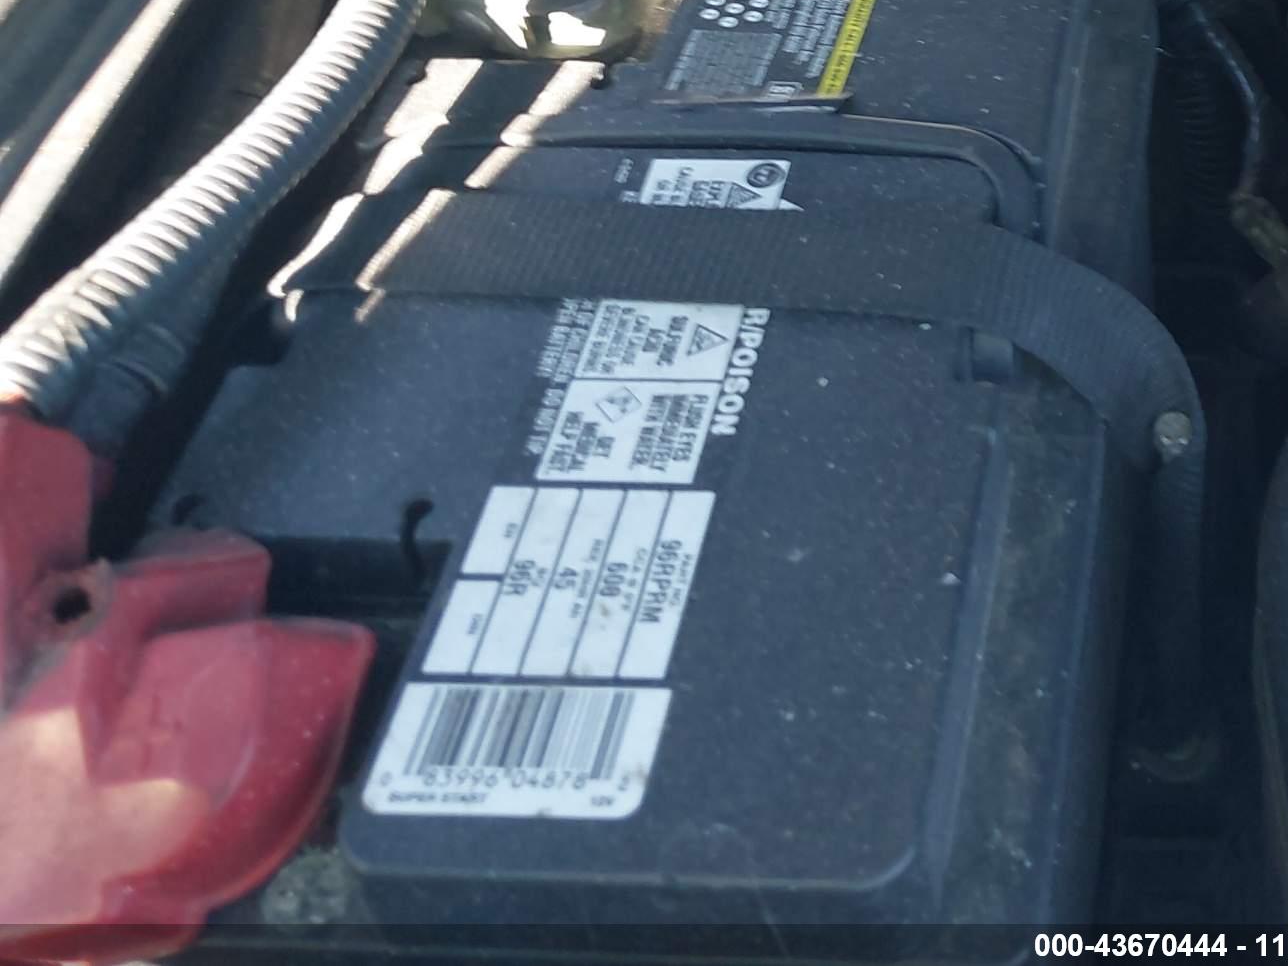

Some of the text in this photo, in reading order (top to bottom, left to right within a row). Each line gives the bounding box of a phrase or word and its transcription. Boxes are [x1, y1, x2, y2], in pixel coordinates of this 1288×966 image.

[502, 560, 535, 596] 96R
[552, 567, 579, 589] 45
[597, 562, 628, 597] 600
[638, 539, 682, 622] 96RPRM
